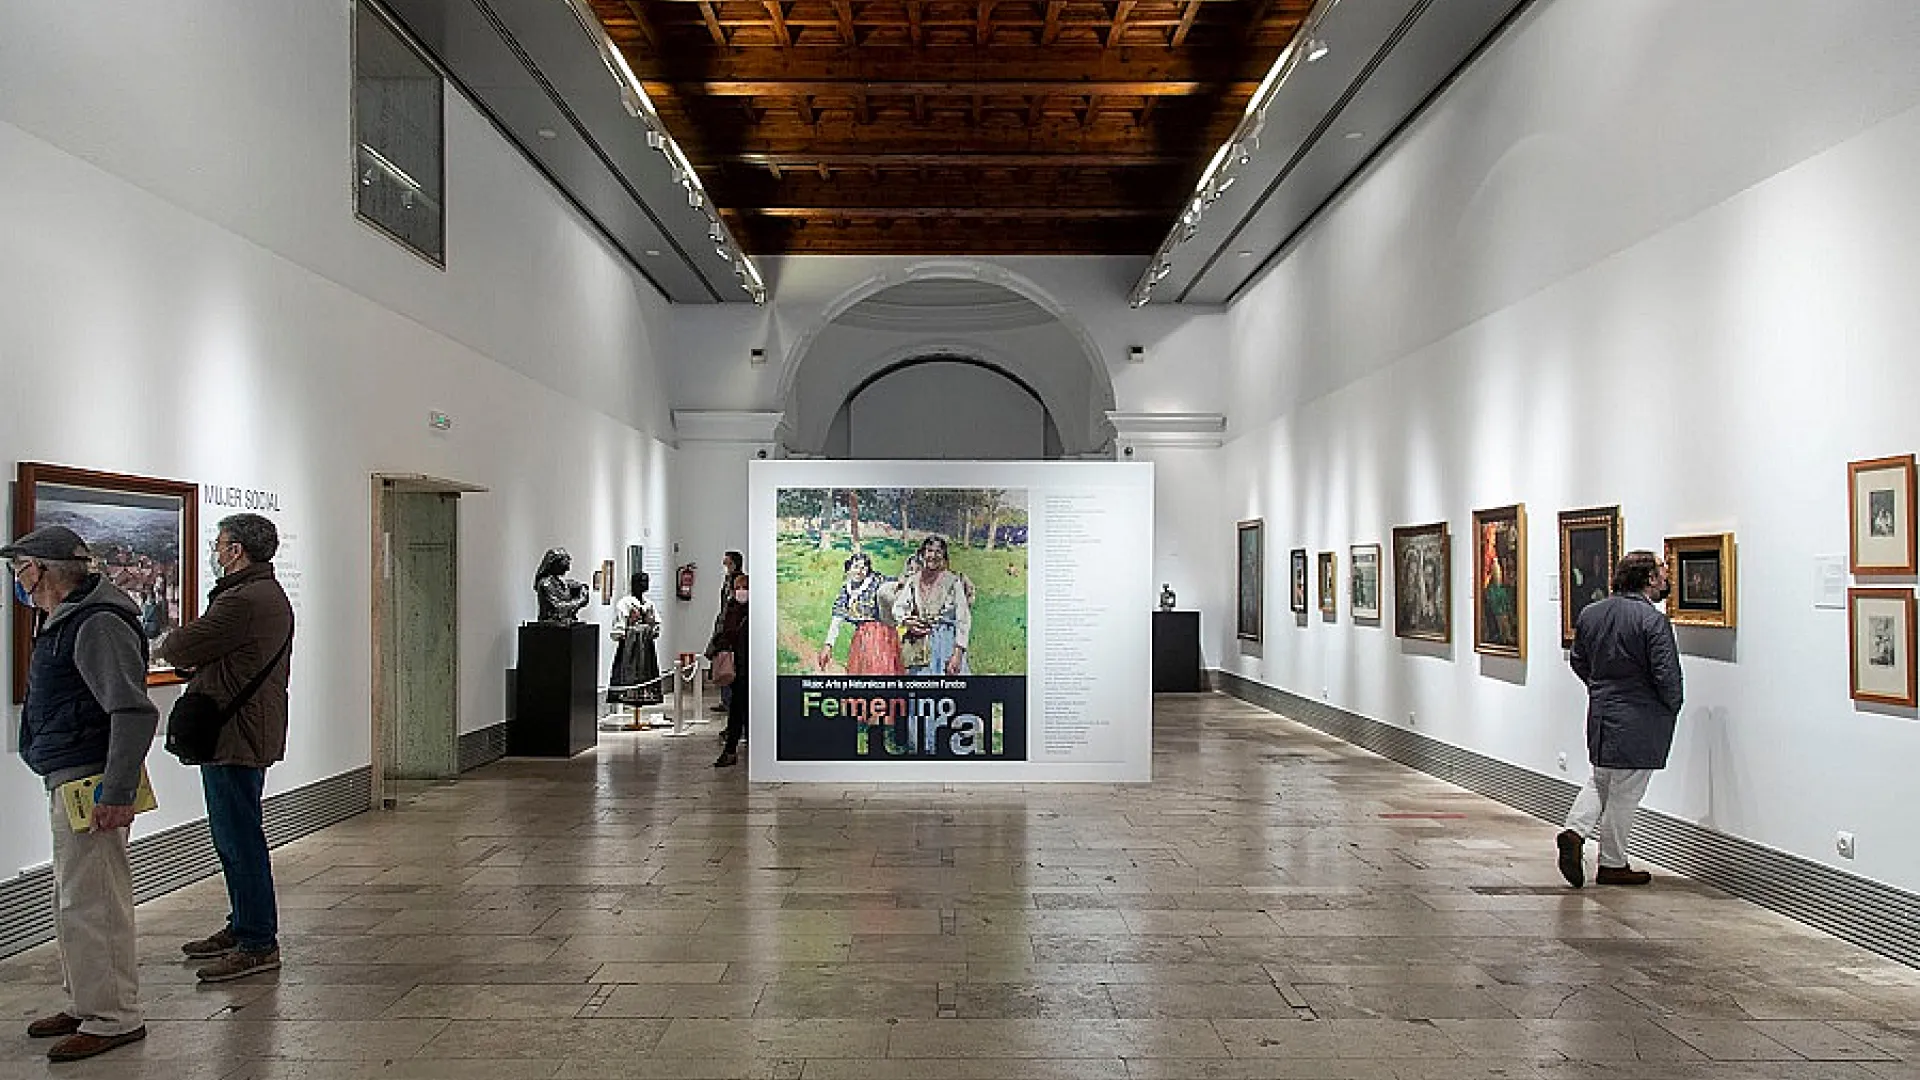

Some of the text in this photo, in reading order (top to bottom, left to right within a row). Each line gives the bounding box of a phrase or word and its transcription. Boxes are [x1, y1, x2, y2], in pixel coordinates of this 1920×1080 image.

[205, 484, 280, 512] MUJER SOCIAL
[803, 692, 957, 717] Femenino
[857, 702, 1004, 755] rural
